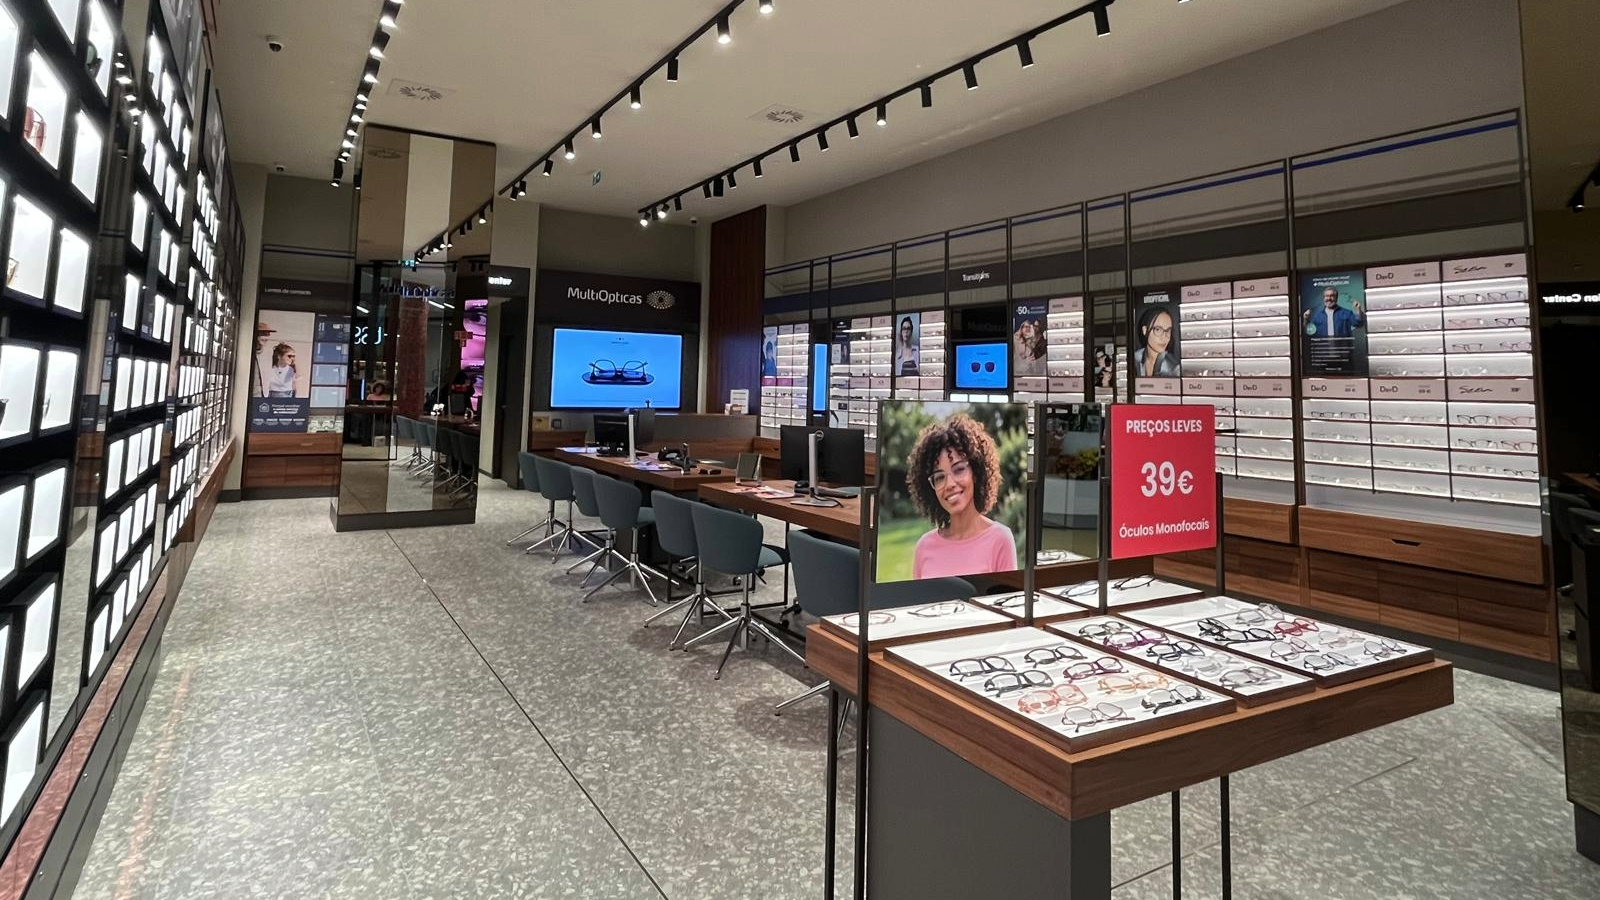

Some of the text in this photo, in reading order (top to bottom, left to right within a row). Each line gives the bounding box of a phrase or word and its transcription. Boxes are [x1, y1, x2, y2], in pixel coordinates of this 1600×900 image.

[567, 286, 643, 305] MultiOpticas
[1126, 419, 1203, 437] PREÇOS LEVES
[1141, 461, 1194, 497] 39€
[1119, 517, 1210, 538] Óculos Monofocais
